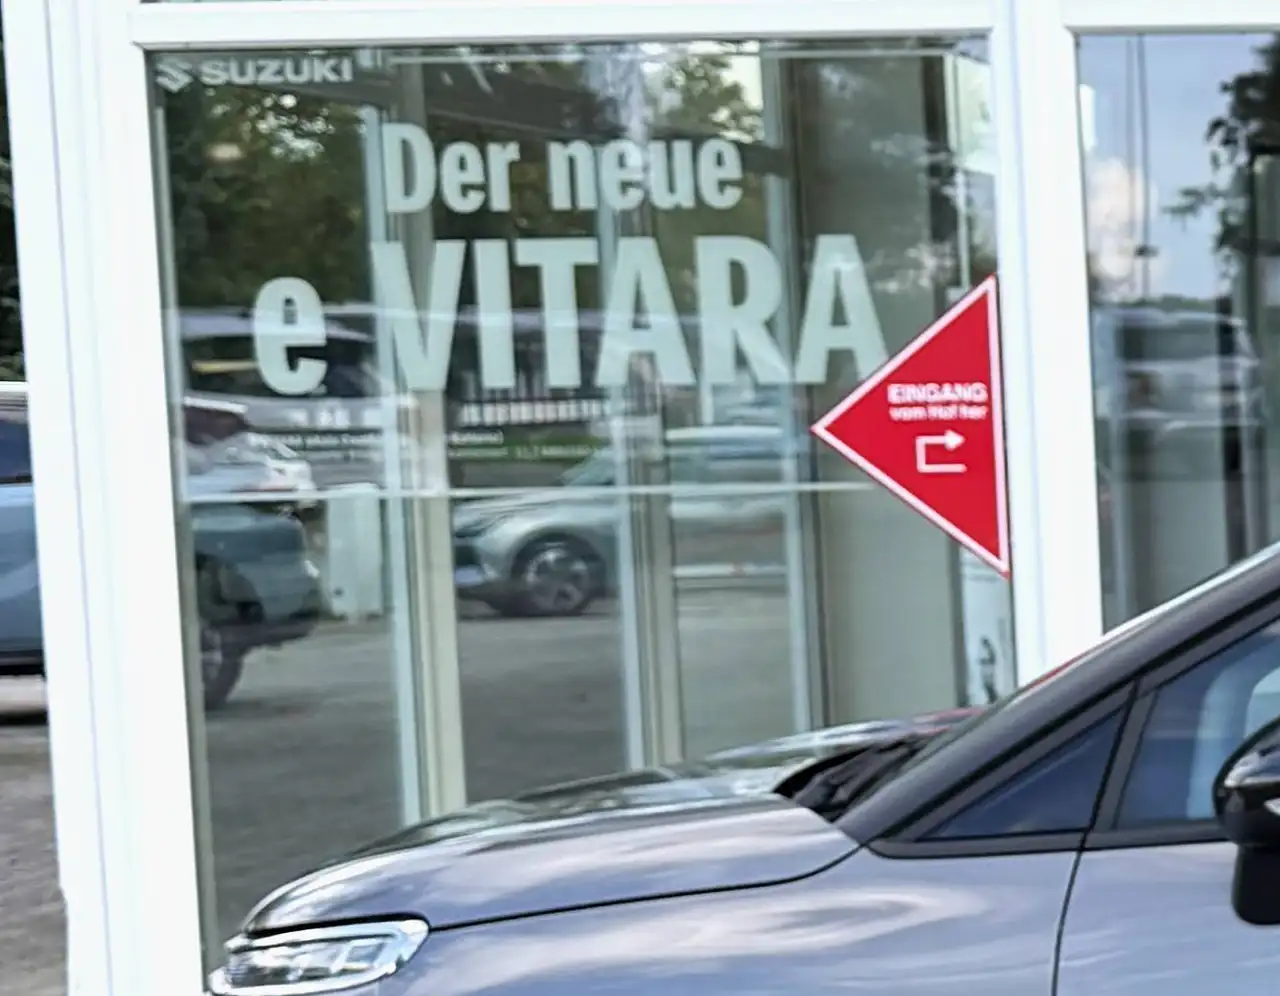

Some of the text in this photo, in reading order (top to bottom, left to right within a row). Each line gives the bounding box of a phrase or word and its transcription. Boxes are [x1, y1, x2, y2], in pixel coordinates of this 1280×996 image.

[201, 57, 353, 85] SUZUKI
[382, 122, 743, 213] Der neue
[253, 234, 889, 396] e VITARA
[887, 382, 988, 404] EINGANG
